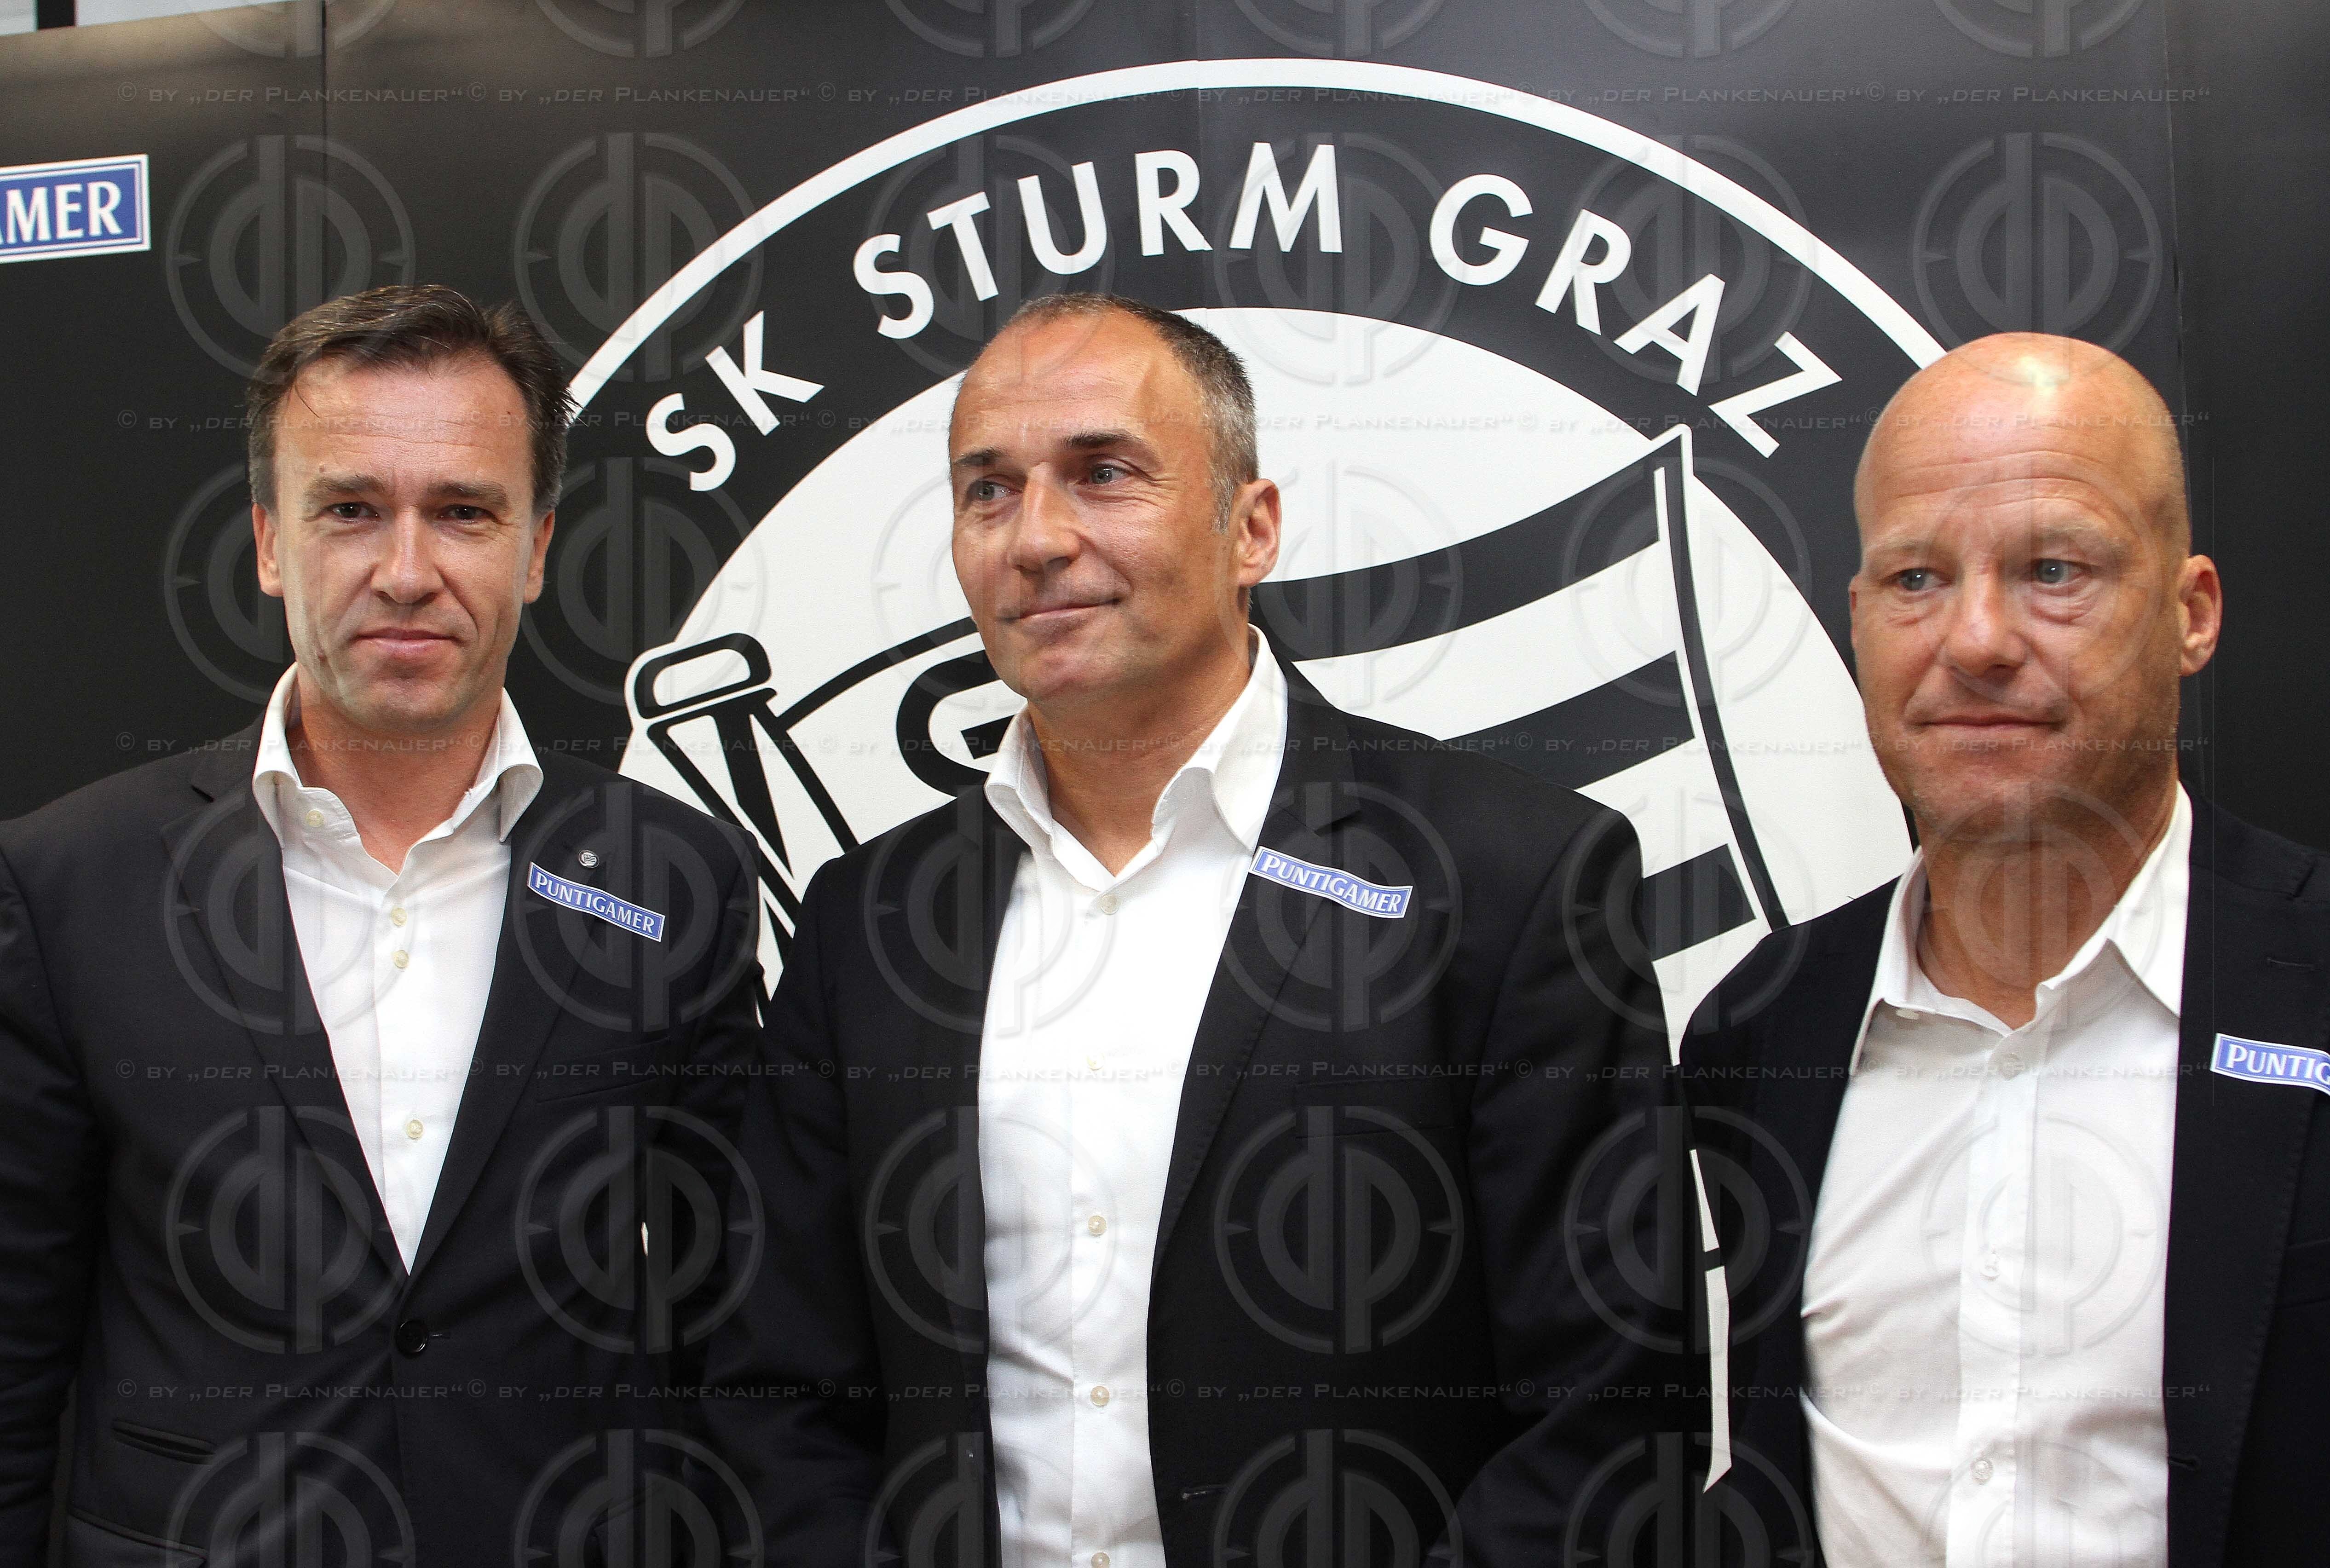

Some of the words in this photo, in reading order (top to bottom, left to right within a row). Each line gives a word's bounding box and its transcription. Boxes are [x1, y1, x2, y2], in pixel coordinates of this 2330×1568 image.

[0, 181, 122, 244] MER
[646, 311, 824, 491] SK
[853, 142, 1342, 339] STURM
[1430, 174, 1843, 458] GRAZ
[535, 872, 655, 934] PUNTIGAMER
[1261, 854, 1402, 913] PUNTIGAMER
